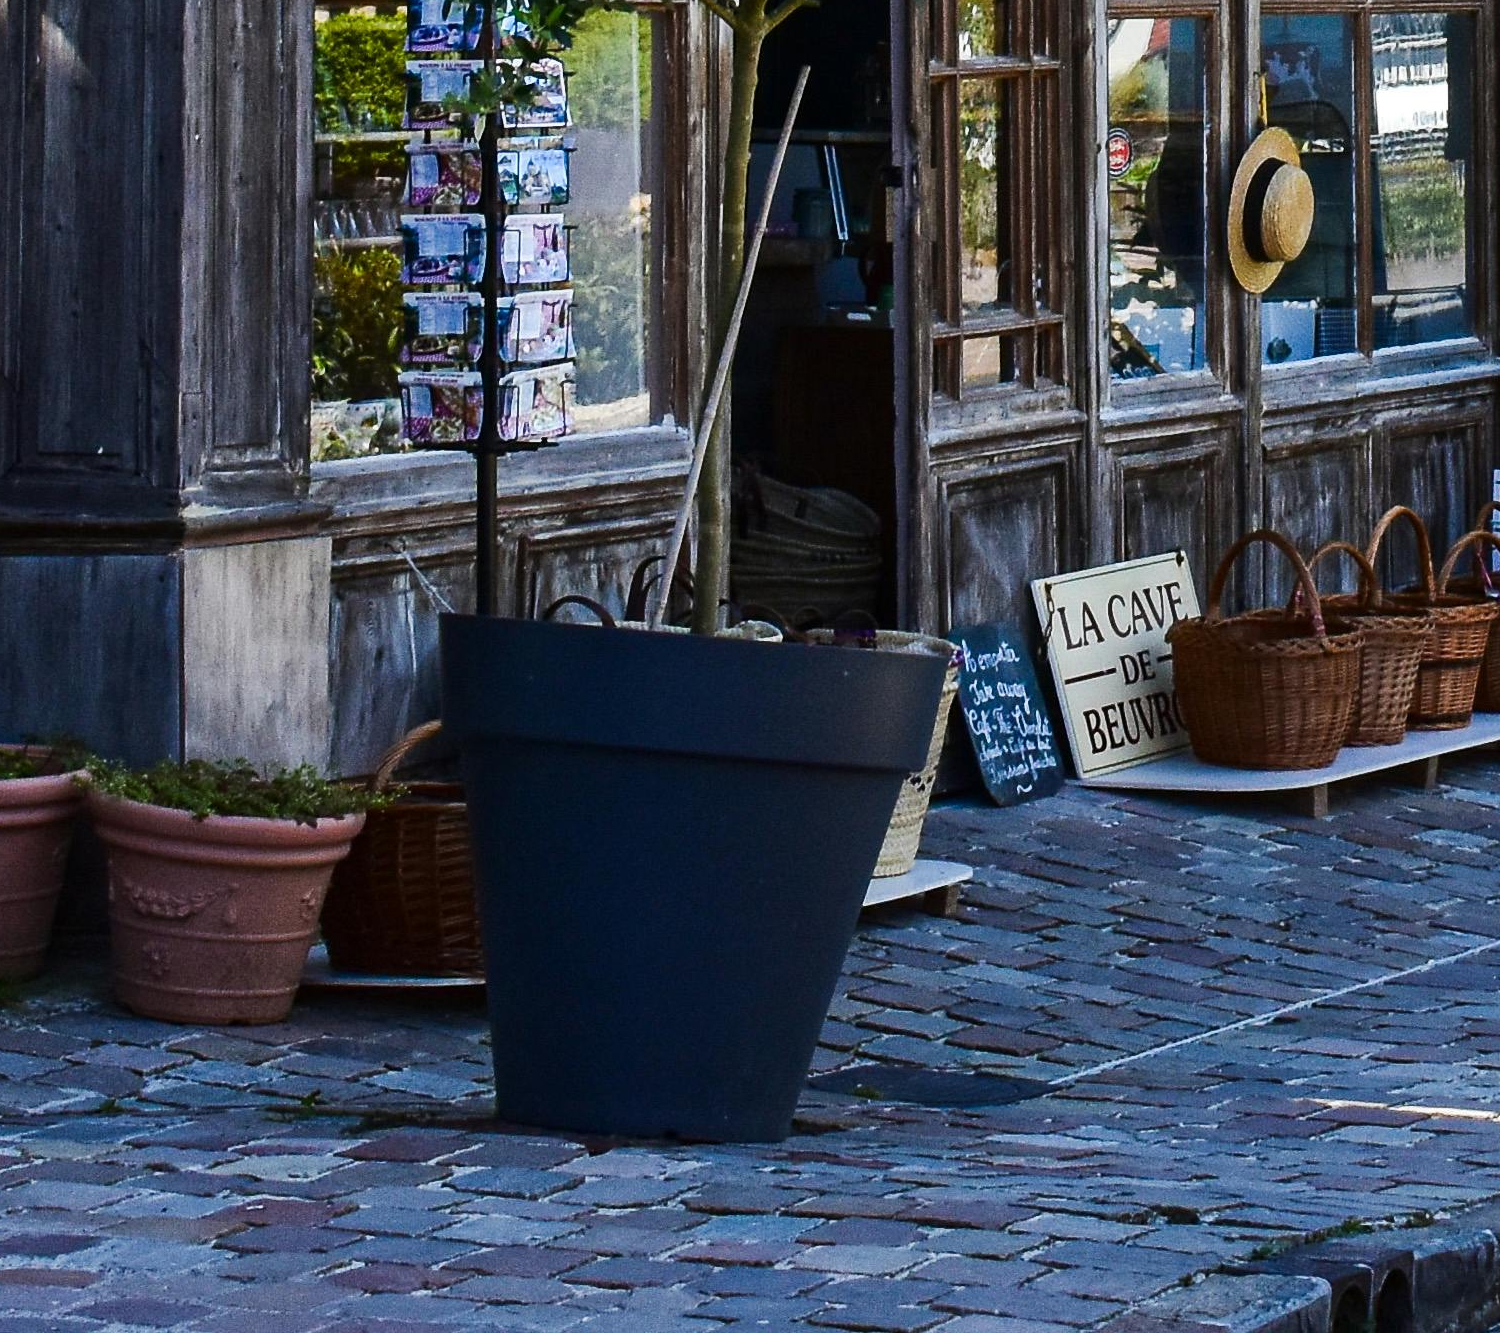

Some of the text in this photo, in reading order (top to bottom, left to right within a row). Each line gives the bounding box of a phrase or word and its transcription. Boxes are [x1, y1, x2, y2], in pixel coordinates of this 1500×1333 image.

[1057, 581, 1189, 650] LA CAVE
[1119, 650, 1156, 686] DE
